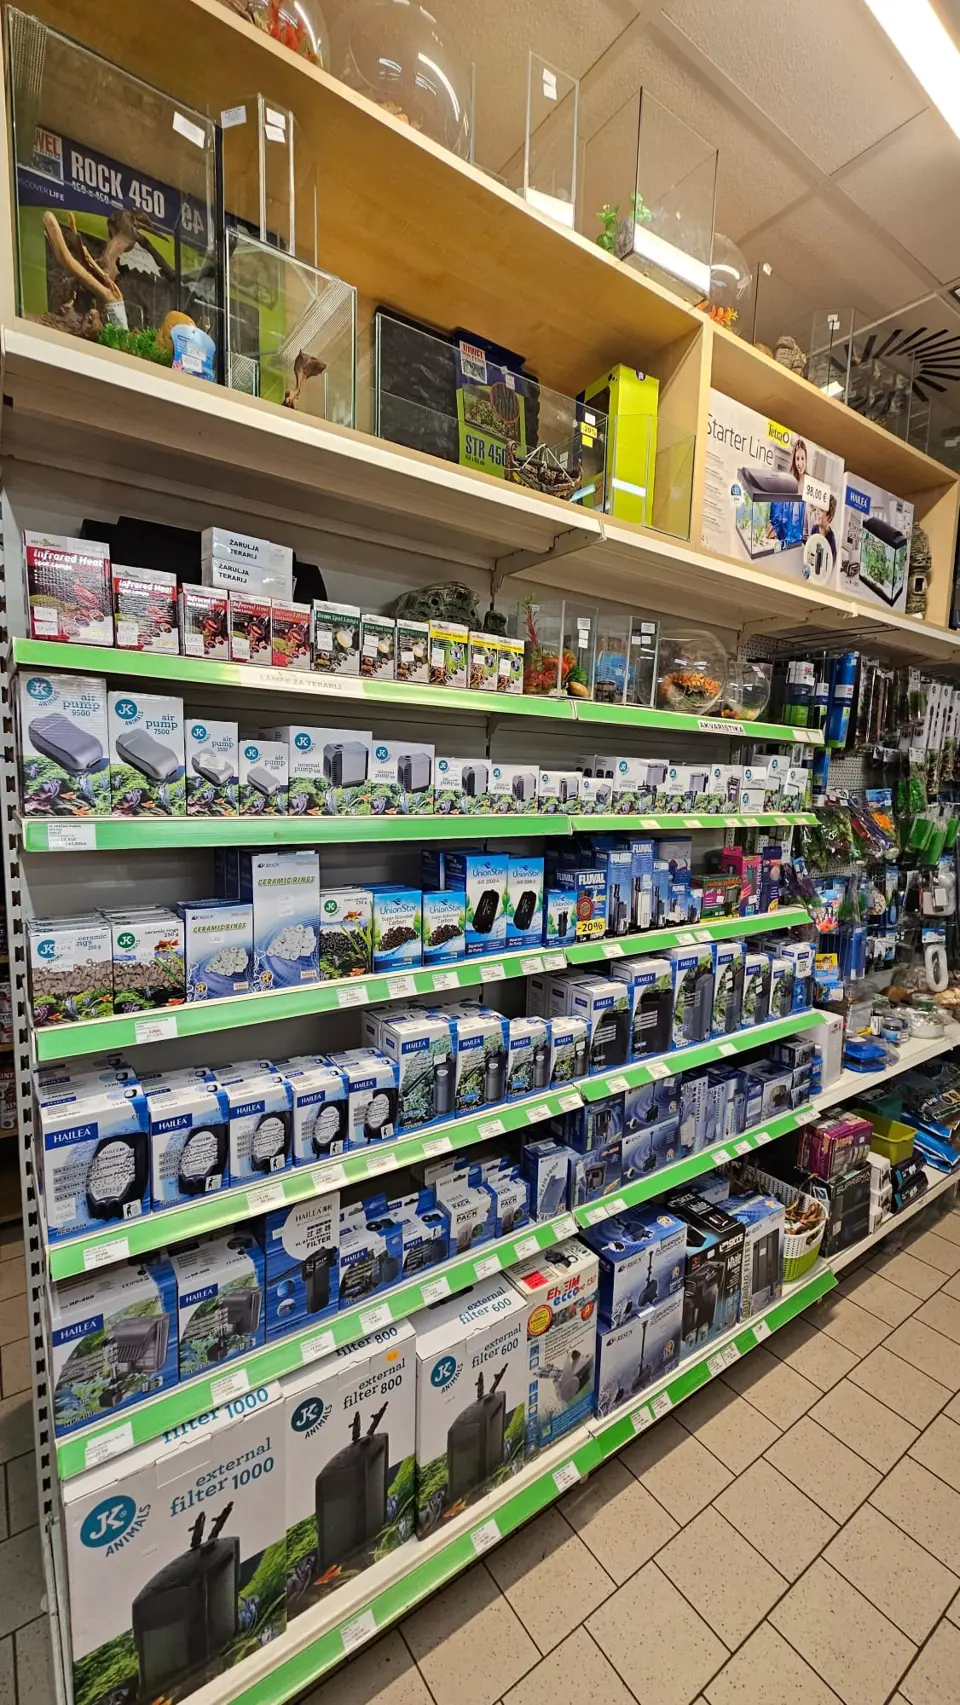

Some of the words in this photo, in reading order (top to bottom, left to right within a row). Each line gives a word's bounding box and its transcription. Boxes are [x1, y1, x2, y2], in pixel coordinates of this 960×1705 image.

[71, 150, 124, 200] ROCK
[129, 180, 165, 219] 450
[49, 189, 65, 202] LIFE
[706, 412, 747, 452] Starter
[749, 436, 774, 466] Line
[465, 434, 485, 460] STR
[229, 538, 259, 552] ŽARULJA
[33, 548, 78, 564] Infrared
[79, 555, 104, 568] Heat
[230, 548, 258, 560] TERARIJ
[218, 563, 249, 576] ŽARULJA
[218, 571, 248, 584] TERARIJ
[119, 579, 153, 591] Infrared
[30, 681, 49, 696] JK
[306, 680, 342, 690] TERARIJ
[81, 693, 97, 702] air
[63, 700, 101, 712] pump
[118, 703, 135, 716] JK
[124, 710, 145, 726] ANIMALS
[145, 720, 178, 731] pump
[153, 728, 170, 736] 7500
[700, 721, 744, 733] AKVARISTIKA
[193, 728, 205, 738] JK
[211, 740, 235, 749] pump
[297, 736, 309, 747] JK
[246, 749, 257, 758] JK
[377, 749, 386, 758] JK
[264, 759, 286, 767] pump
[632, 843, 653, 854] FLUVAL
[472, 868, 504, 878] UnionStar
[512, 869, 540, 879] UnionStar
[556, 872, 575, 883] FLUVAL
[578, 872, 606, 886] FLUVAL
[325, 902, 336, 911] JK
[380, 903, 417, 915] UnionStar
[429, 903, 461, 914] UnionStar
[577, 920, 603, 933] -20%
[77, 934, 107, 942] ceramic
[119, 935, 133, 946] JK
[40, 943, 55, 955] JK
[681, 959, 697, 968] HAILEA
[637, 975, 655, 984] HAILEA
[405, 1040, 427, 1050] HAILEA
[462, 1038, 481, 1048] HAILEA
[513, 1038, 530, 1047] HAILEA
[353, 1079, 374, 1089] HAILEA
[301, 1093, 322, 1104] HAILEA
[236, 1103, 262, 1115] HAILEA
[158, 1117, 188, 1131] HAILEA
[53, 1127, 92, 1144] HAILEA
[500, 1197, 517, 1208] PACK
[295, 1207, 322, 1222] HAILEA
[456, 1210, 478, 1223] PACK
[306, 1235, 331, 1249] FILTER
[344, 1252, 365, 1263] HAILEA
[185, 1289, 213, 1303] HAILEA
[466, 1286, 507, 1311] external
[553, 1286, 580, 1306] ecco
[458, 1305, 490, 1326] filter
[492, 1297, 512, 1315] 600
[60, 1320, 97, 1340] HAILEA
[375, 1326, 398, 1346] 800
[483, 1323, 523, 1352] external
[471, 1347, 500, 1369] filter
[501, 1338, 519, 1356] 600
[358, 1359, 406, 1391] external
[434, 1361, 453, 1381] JK
[440, 1361, 464, 1395] ANIMALS
[342, 1384, 379, 1410] filter
[380, 1375, 402, 1397] 800
[225, 1387, 269, 1420] 1000
[296, 1402, 318, 1427] JK
[304, 1403, 333, 1440] ANIMALS
[195, 1436, 273, 1488] external
[169, 1476, 228, 1518] filter
[231, 1456, 275, 1491] 1000
[89, 1502, 125, 1541] JK
[104, 1503, 152, 1558] ANIMALS
